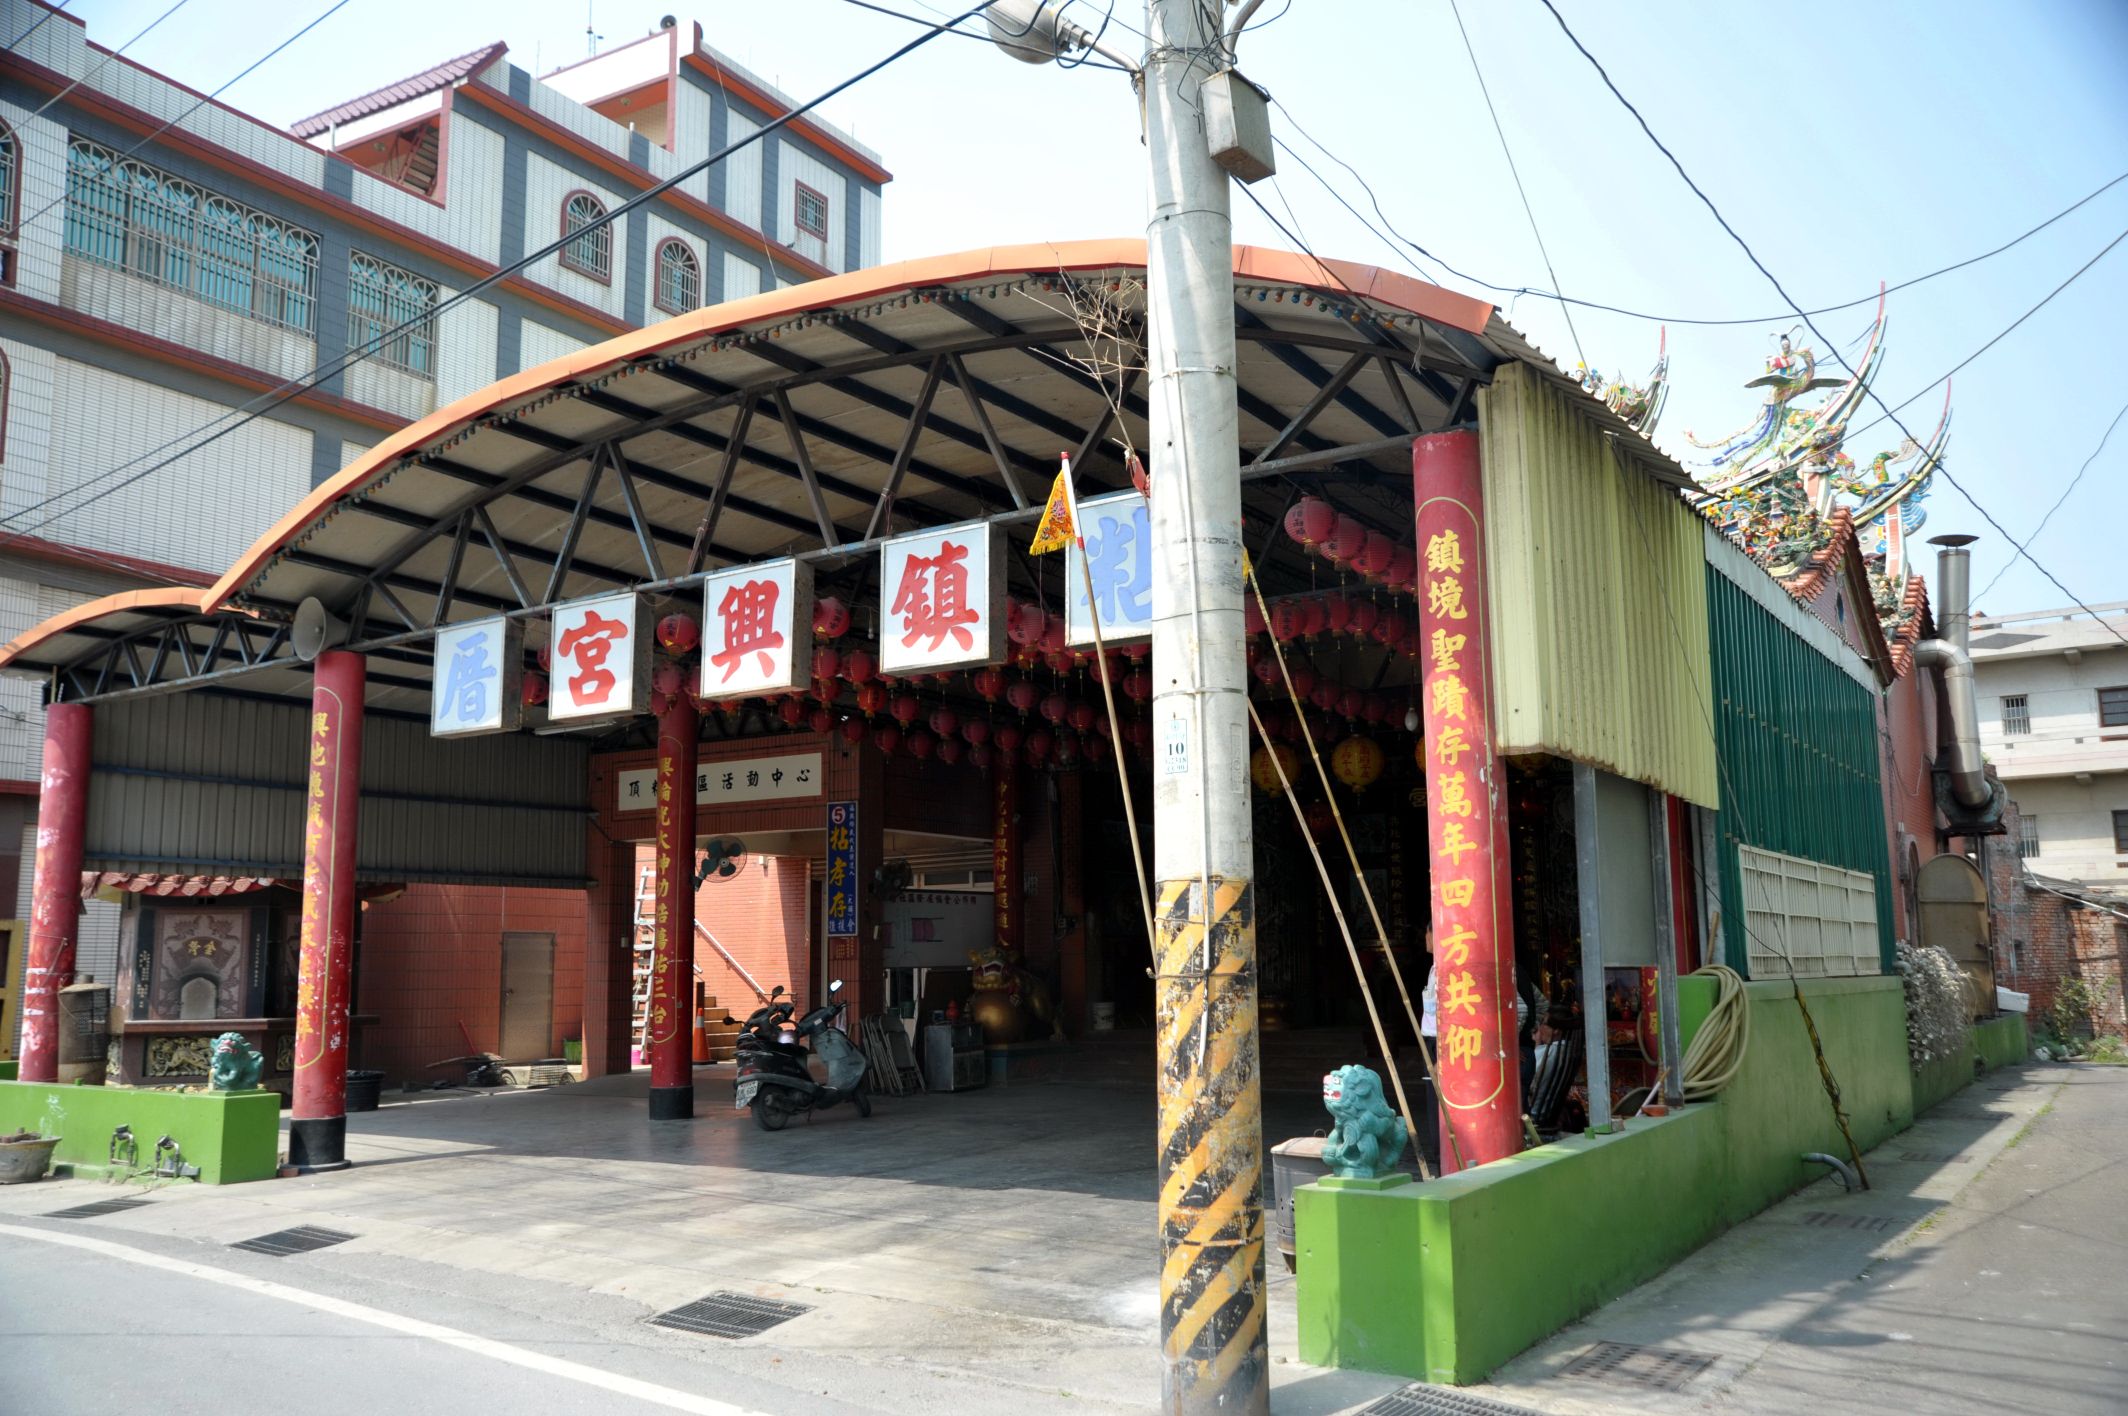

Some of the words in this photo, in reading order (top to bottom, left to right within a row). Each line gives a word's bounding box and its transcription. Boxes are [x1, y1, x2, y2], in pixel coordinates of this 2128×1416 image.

[711, 580, 784, 684] 興
[890, 540, 981, 652] 鎮
[558, 610, 629, 707] 宮
[1168, 742, 1184, 756] 10
[1423, 533, 1482, 1073] 鎮境聖蹟存萬年四方共仰
